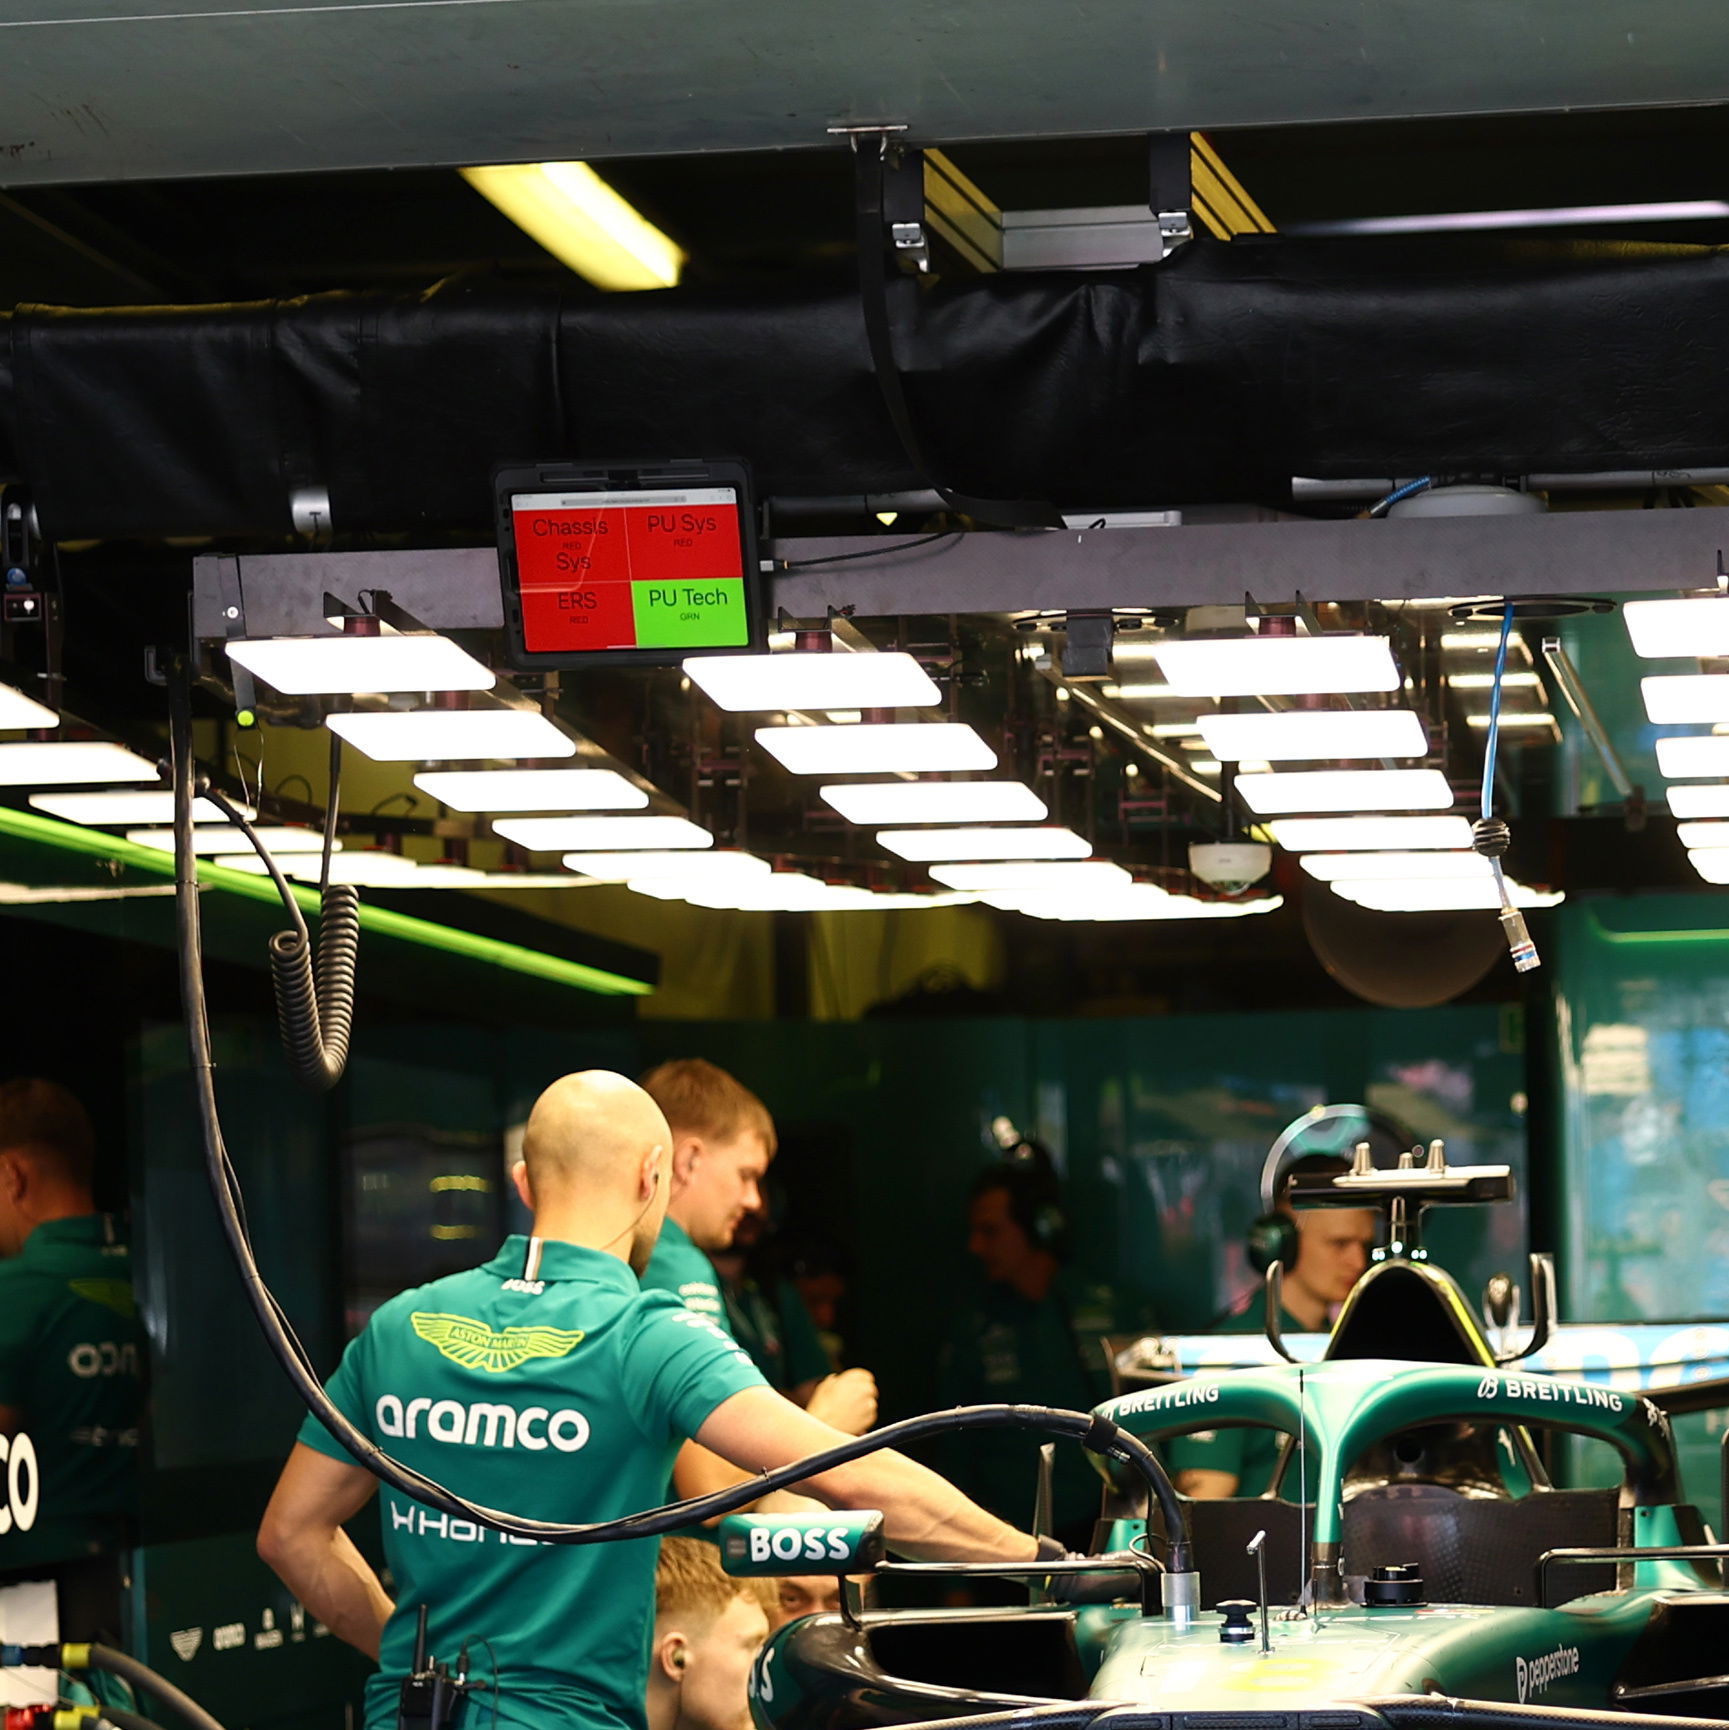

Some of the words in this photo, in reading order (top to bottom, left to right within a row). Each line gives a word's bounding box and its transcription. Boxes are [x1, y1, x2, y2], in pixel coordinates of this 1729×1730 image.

[532, 518, 609, 537] Chassis
[647, 514, 676, 533] PU
[682, 513, 717, 535] Sys
[562, 541, 582, 550] RED
[674, 538, 693, 548] RED
[556, 551, 592, 573] Sys
[557, 591, 598, 610] ERS
[648, 589, 677, 607] PU
[682, 587, 728, 606] Tech
[569, 616, 589, 625] RED
[679, 612, 700, 621] GRN
[1119, 1383, 1220, 1417] BREITLING
[1505, 1378, 1623, 1412] BREITLING
[375, 1394, 591, 1452] aramco
[418, 1510, 558, 1546] Hon
[748, 1527, 851, 1562] BOSS
[1528, 1643, 1580, 1698] pepperstone
